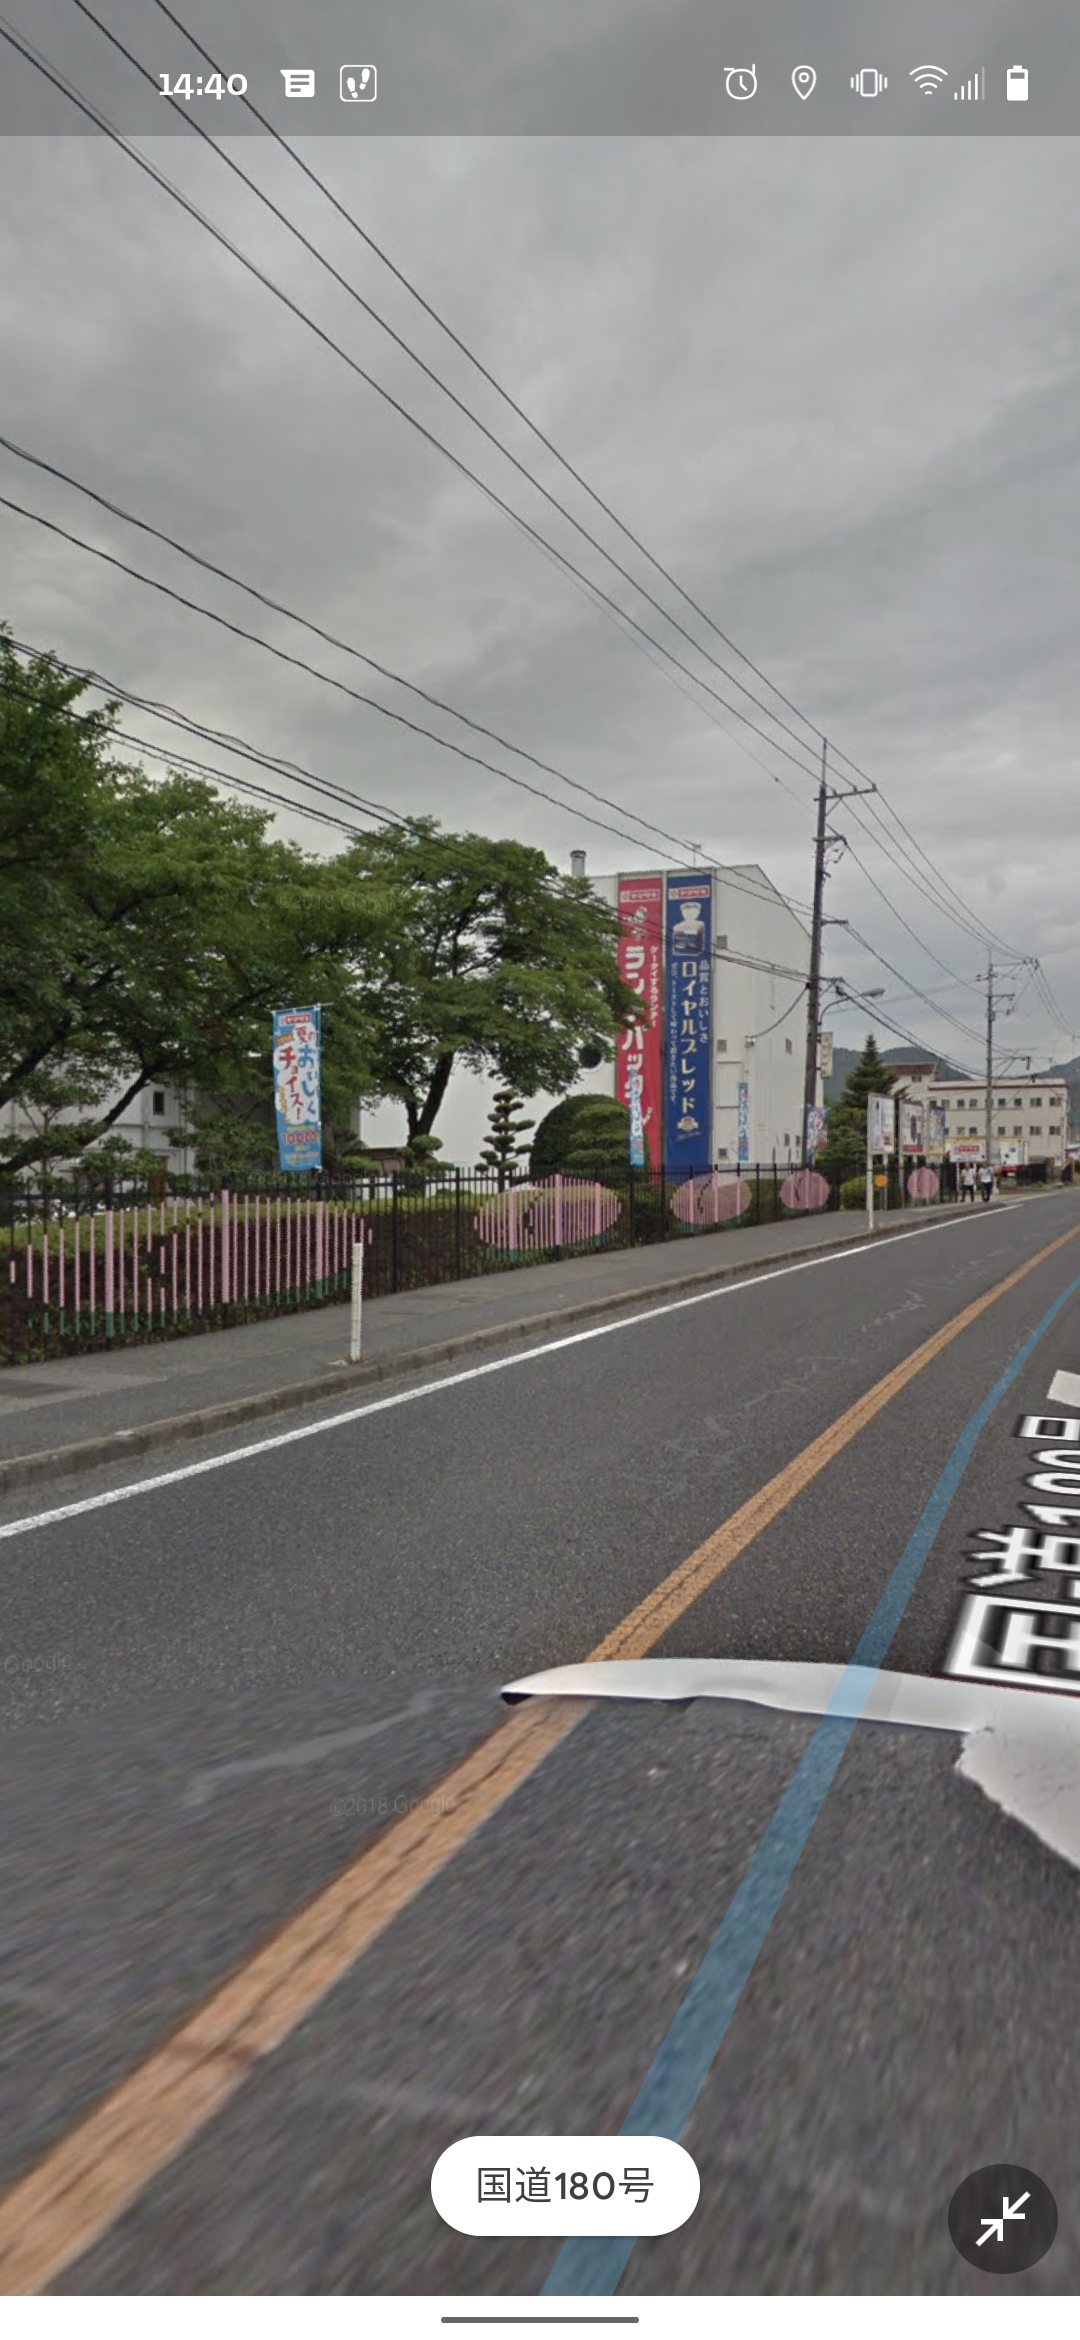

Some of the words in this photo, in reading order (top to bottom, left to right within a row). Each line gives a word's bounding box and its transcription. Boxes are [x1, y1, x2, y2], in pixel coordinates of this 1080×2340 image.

[297, 1045, 318, 1114] おいしく
[681, 961, 698, 1114] ロイヤルブレッド
